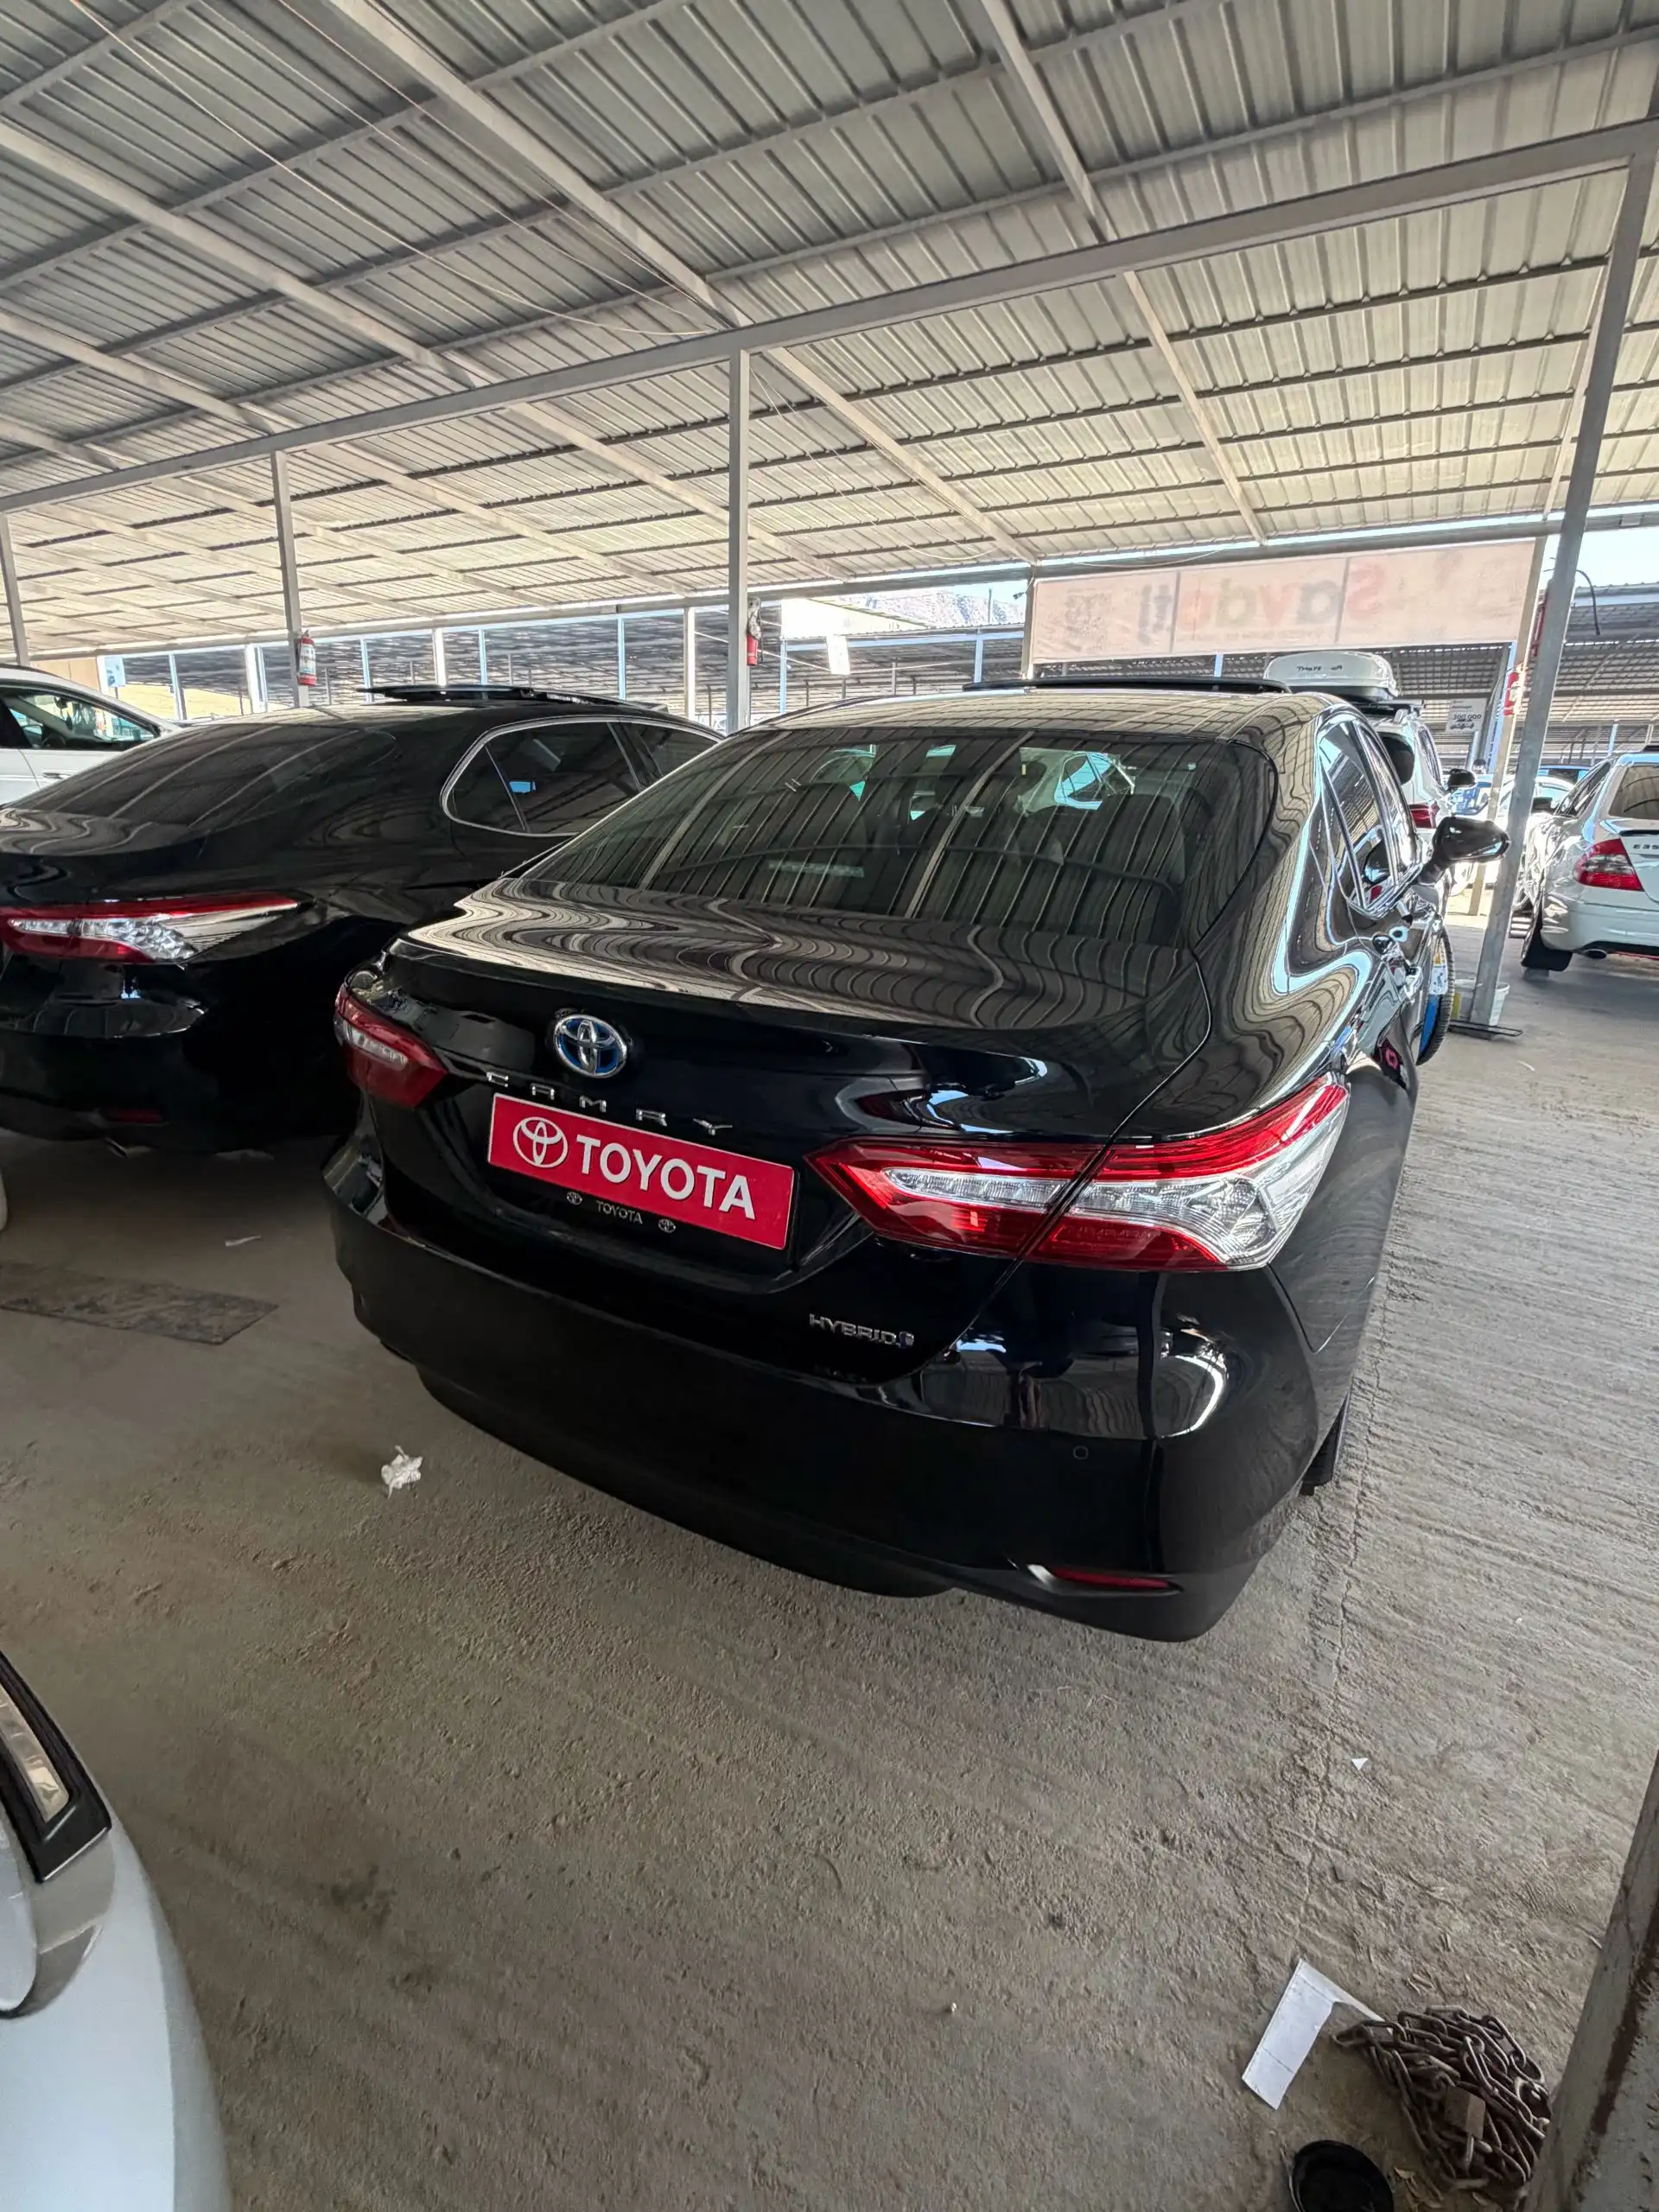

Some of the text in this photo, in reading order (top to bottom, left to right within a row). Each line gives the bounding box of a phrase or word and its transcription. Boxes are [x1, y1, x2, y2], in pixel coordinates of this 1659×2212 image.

[486, 1071, 734, 1136] CAMRY
[576, 1135, 755, 1220] TOYOTA
[596, 1199, 643, 1224] TOYOTA
[809, 1313, 897, 1345] HYBRID
